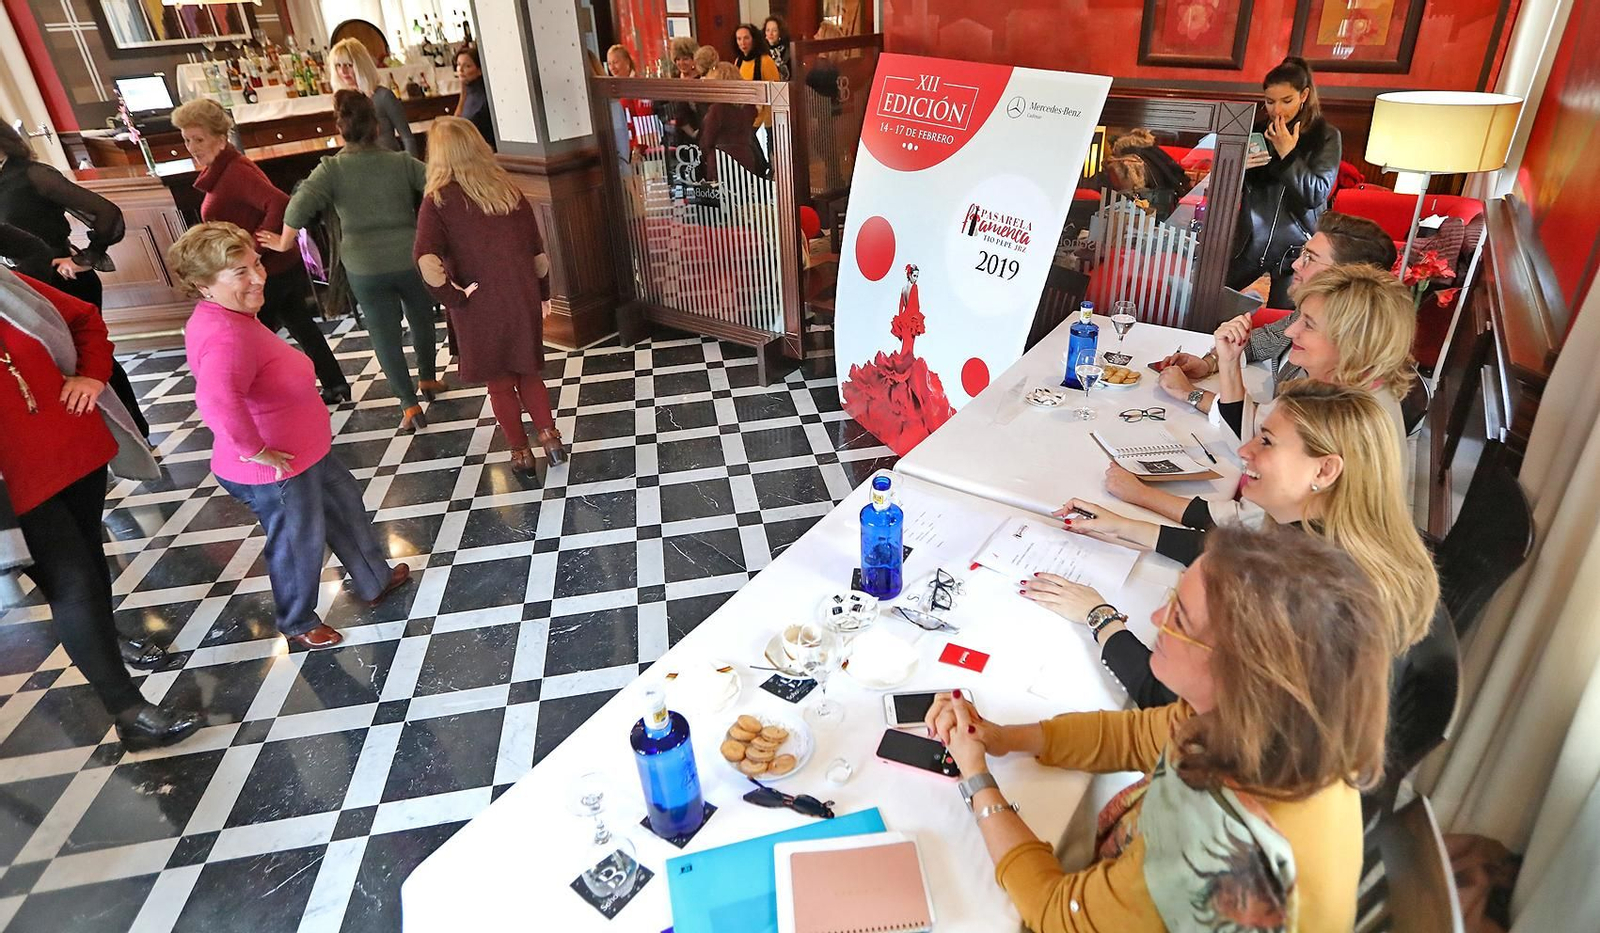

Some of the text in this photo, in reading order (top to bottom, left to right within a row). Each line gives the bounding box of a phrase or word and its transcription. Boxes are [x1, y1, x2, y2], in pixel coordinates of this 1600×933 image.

[916, 74, 941, 92] XII
[883, 92, 967, 123] EDICIÓN
[1029, 101, 1081, 117] Mercedes-Benz
[880, 122, 889, 132] 14
[895, 125, 905, 135] 17
[905, 127, 917, 138] DE
[918, 129, 954, 145] FEBRERO
[981, 209, 1032, 231] PASARELA
[995, 240, 1012, 249] PEPE
[975, 250, 1020, 280] 2019
